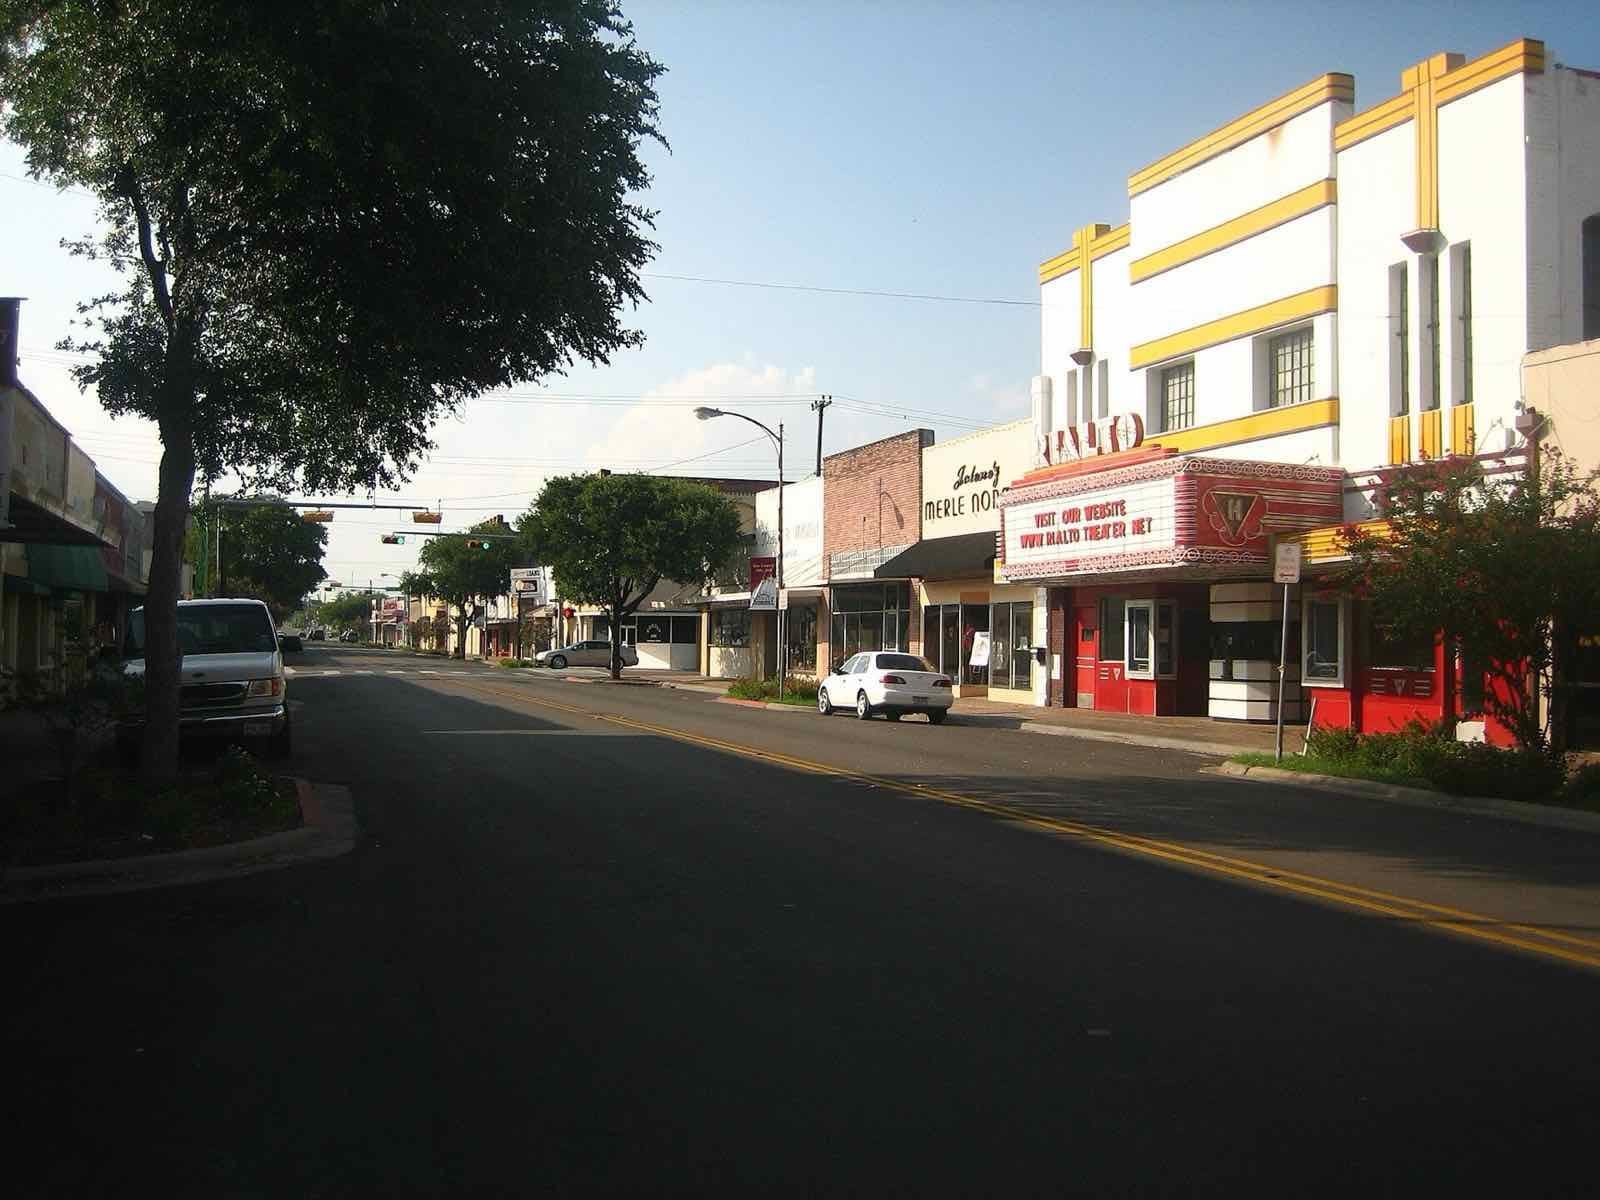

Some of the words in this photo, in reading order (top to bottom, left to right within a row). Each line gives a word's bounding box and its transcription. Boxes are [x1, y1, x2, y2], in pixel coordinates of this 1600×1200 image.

[1033, 412, 1144, 470] RIALTO
[924, 495, 965, 521] MERLE
[971, 487, 1011, 514] NOR
[1034, 511, 1056, 529] VISIT
[1062, 507, 1081, 525] OUR
[1084, 499, 1127, 522] WEBSITE
[1020, 533, 1044, 550] WWW
[1046, 528, 1080, 546] RIALTO
[1131, 516, 1153, 536] NET
